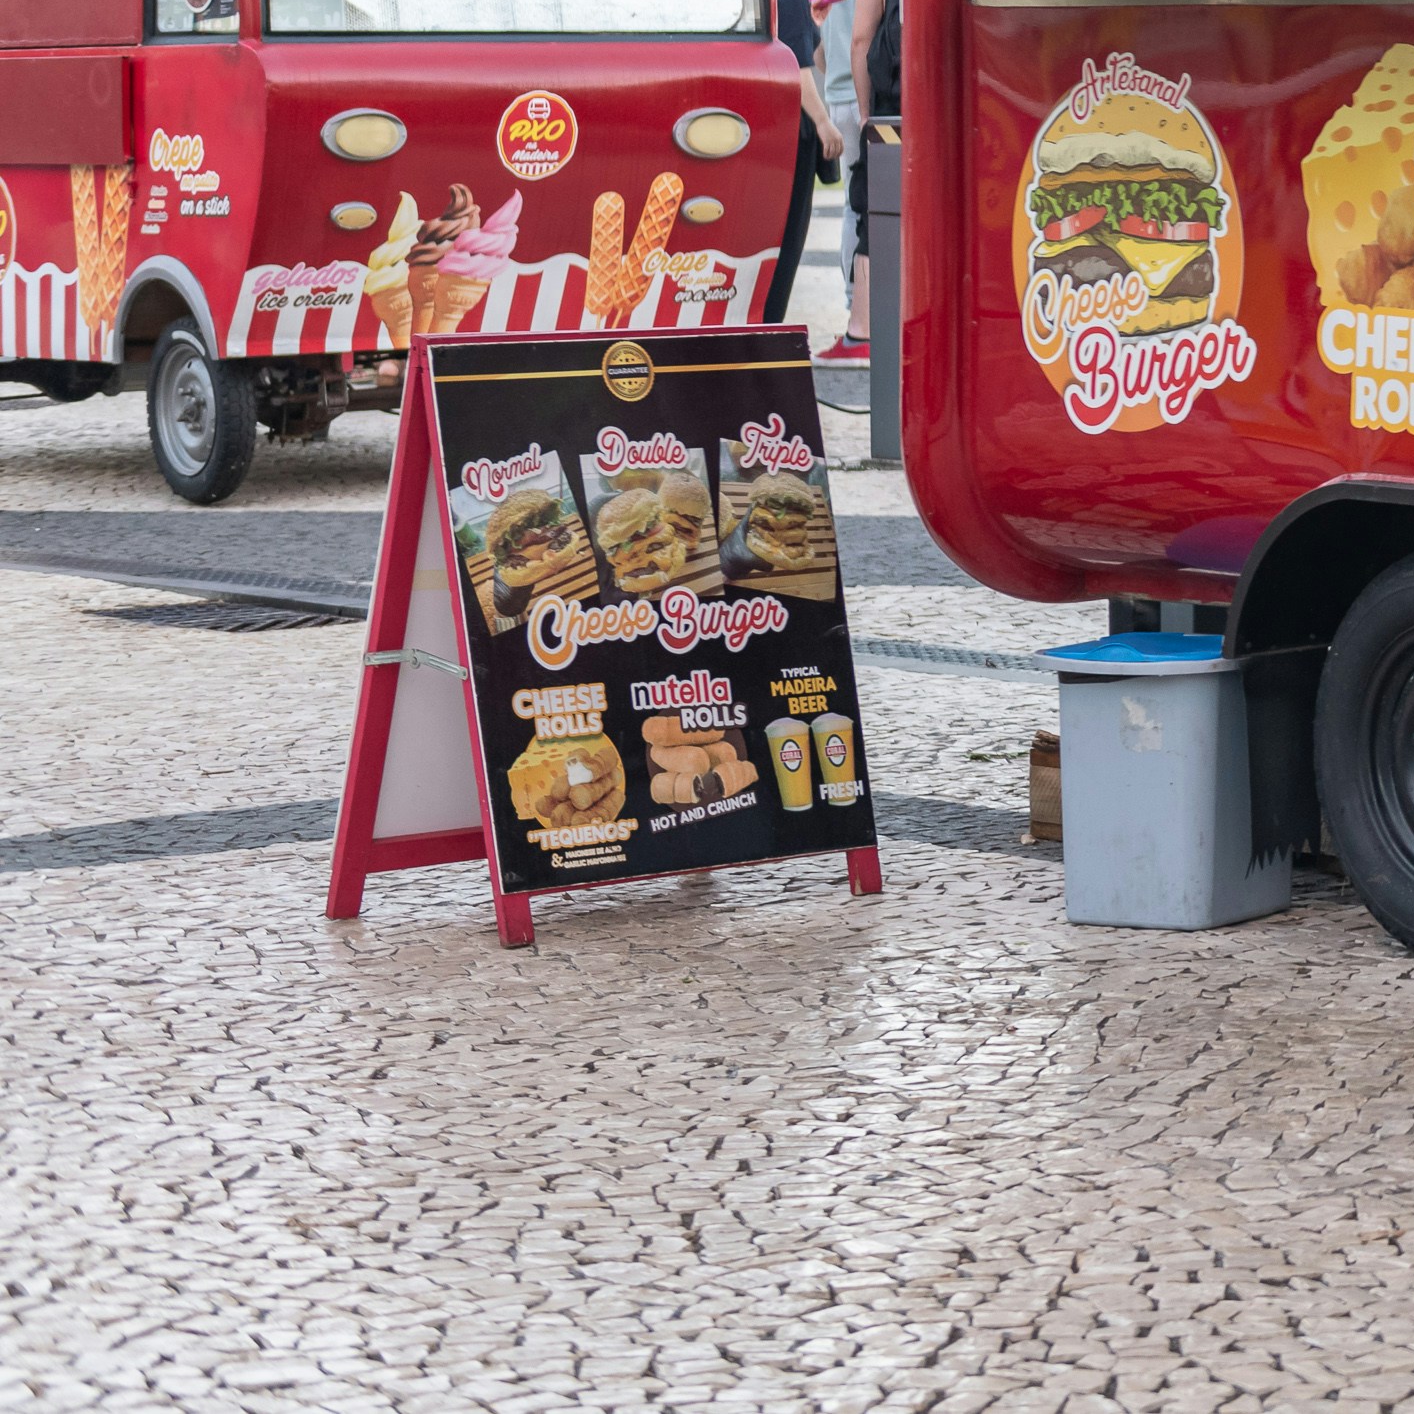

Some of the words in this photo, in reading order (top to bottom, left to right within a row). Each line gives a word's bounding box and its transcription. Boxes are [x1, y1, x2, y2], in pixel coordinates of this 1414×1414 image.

[1071, 53, 1190, 122] Artesanal
[508, 118, 566, 142] PXO
[150, 128, 203, 180] Crepe
[511, 149, 559, 161] Madeira
[180, 199, 194, 216] on
[195, 199, 204, 216] a
[204, 195, 230, 216] stick
[252, 262, 359, 294] gelados
[643, 248, 709, 280] Crepe
[258, 293, 288, 308] ice
[293, 292, 354, 308] cream
[704, 286, 737, 301] stick
[1023, 271, 1148, 362] Cheese
[1069, 322, 1254, 430] Burger
[597, 426, 686, 475] Double
[742, 414, 813, 475] Triple
[465, 443, 543, 498] Normal
[528, 594, 658, 670] Cheese
[658, 586, 788, 653] Burger
[770, 676, 838, 697] MADEIRA
[780, 666, 820, 679] TYPICAL
[513, 683, 607, 717] CHEESE
[632, 670, 732, 711] nutella
[788, 695, 829, 715] BEER
[535, 711, 603, 740] ROLLS
[681, 703, 747, 731] ROLLS
[819, 780, 864, 800] FRESH
[650, 814, 677, 833] HOT
[680, 805, 706, 826] AND
[707, 791, 757, 818] CRUNCH
[551, 853, 564, 868] &
